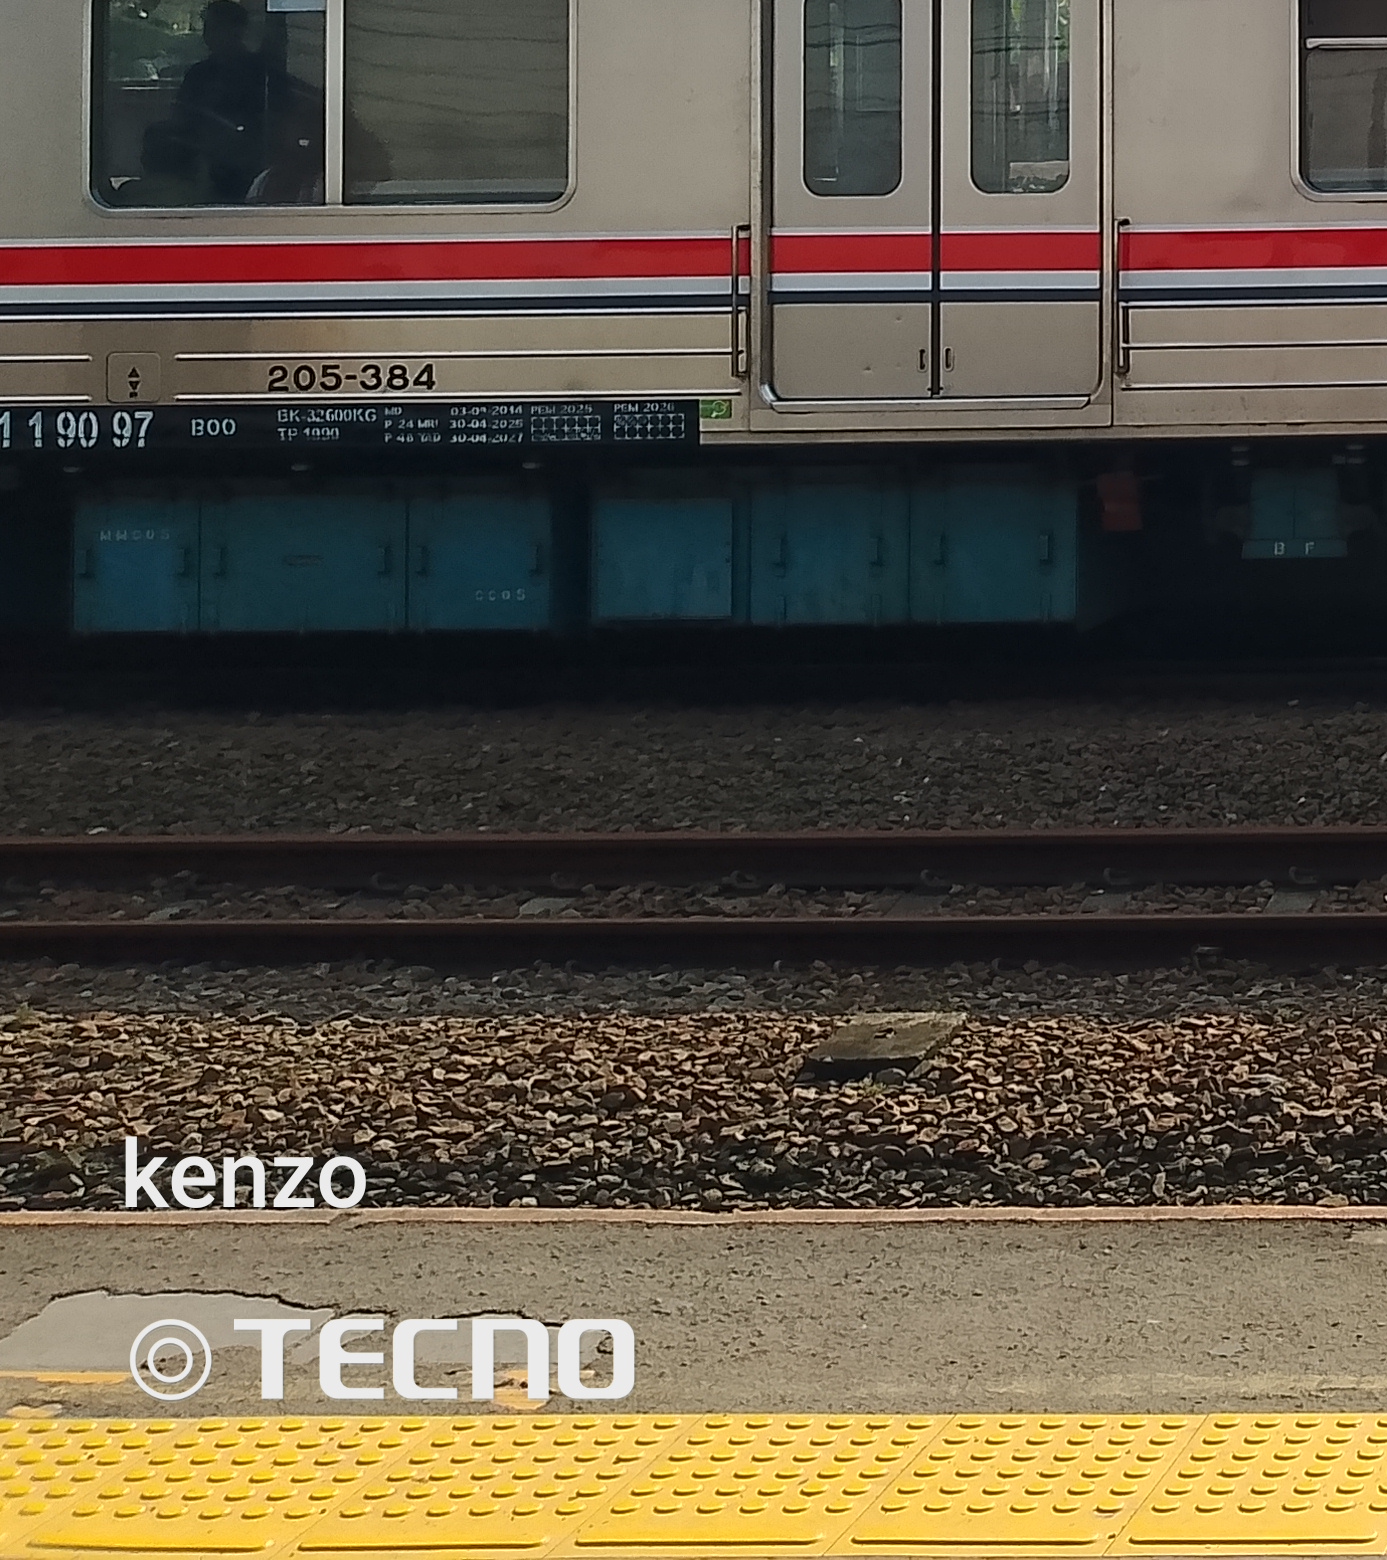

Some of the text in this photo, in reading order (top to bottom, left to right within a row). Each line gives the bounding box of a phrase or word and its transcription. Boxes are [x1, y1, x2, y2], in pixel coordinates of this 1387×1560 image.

[267, 363, 436, 391] 205-384
[56, 410, 98, 448] 90
[112, 410, 154, 448] 97
[277, 427, 298, 441] TP
